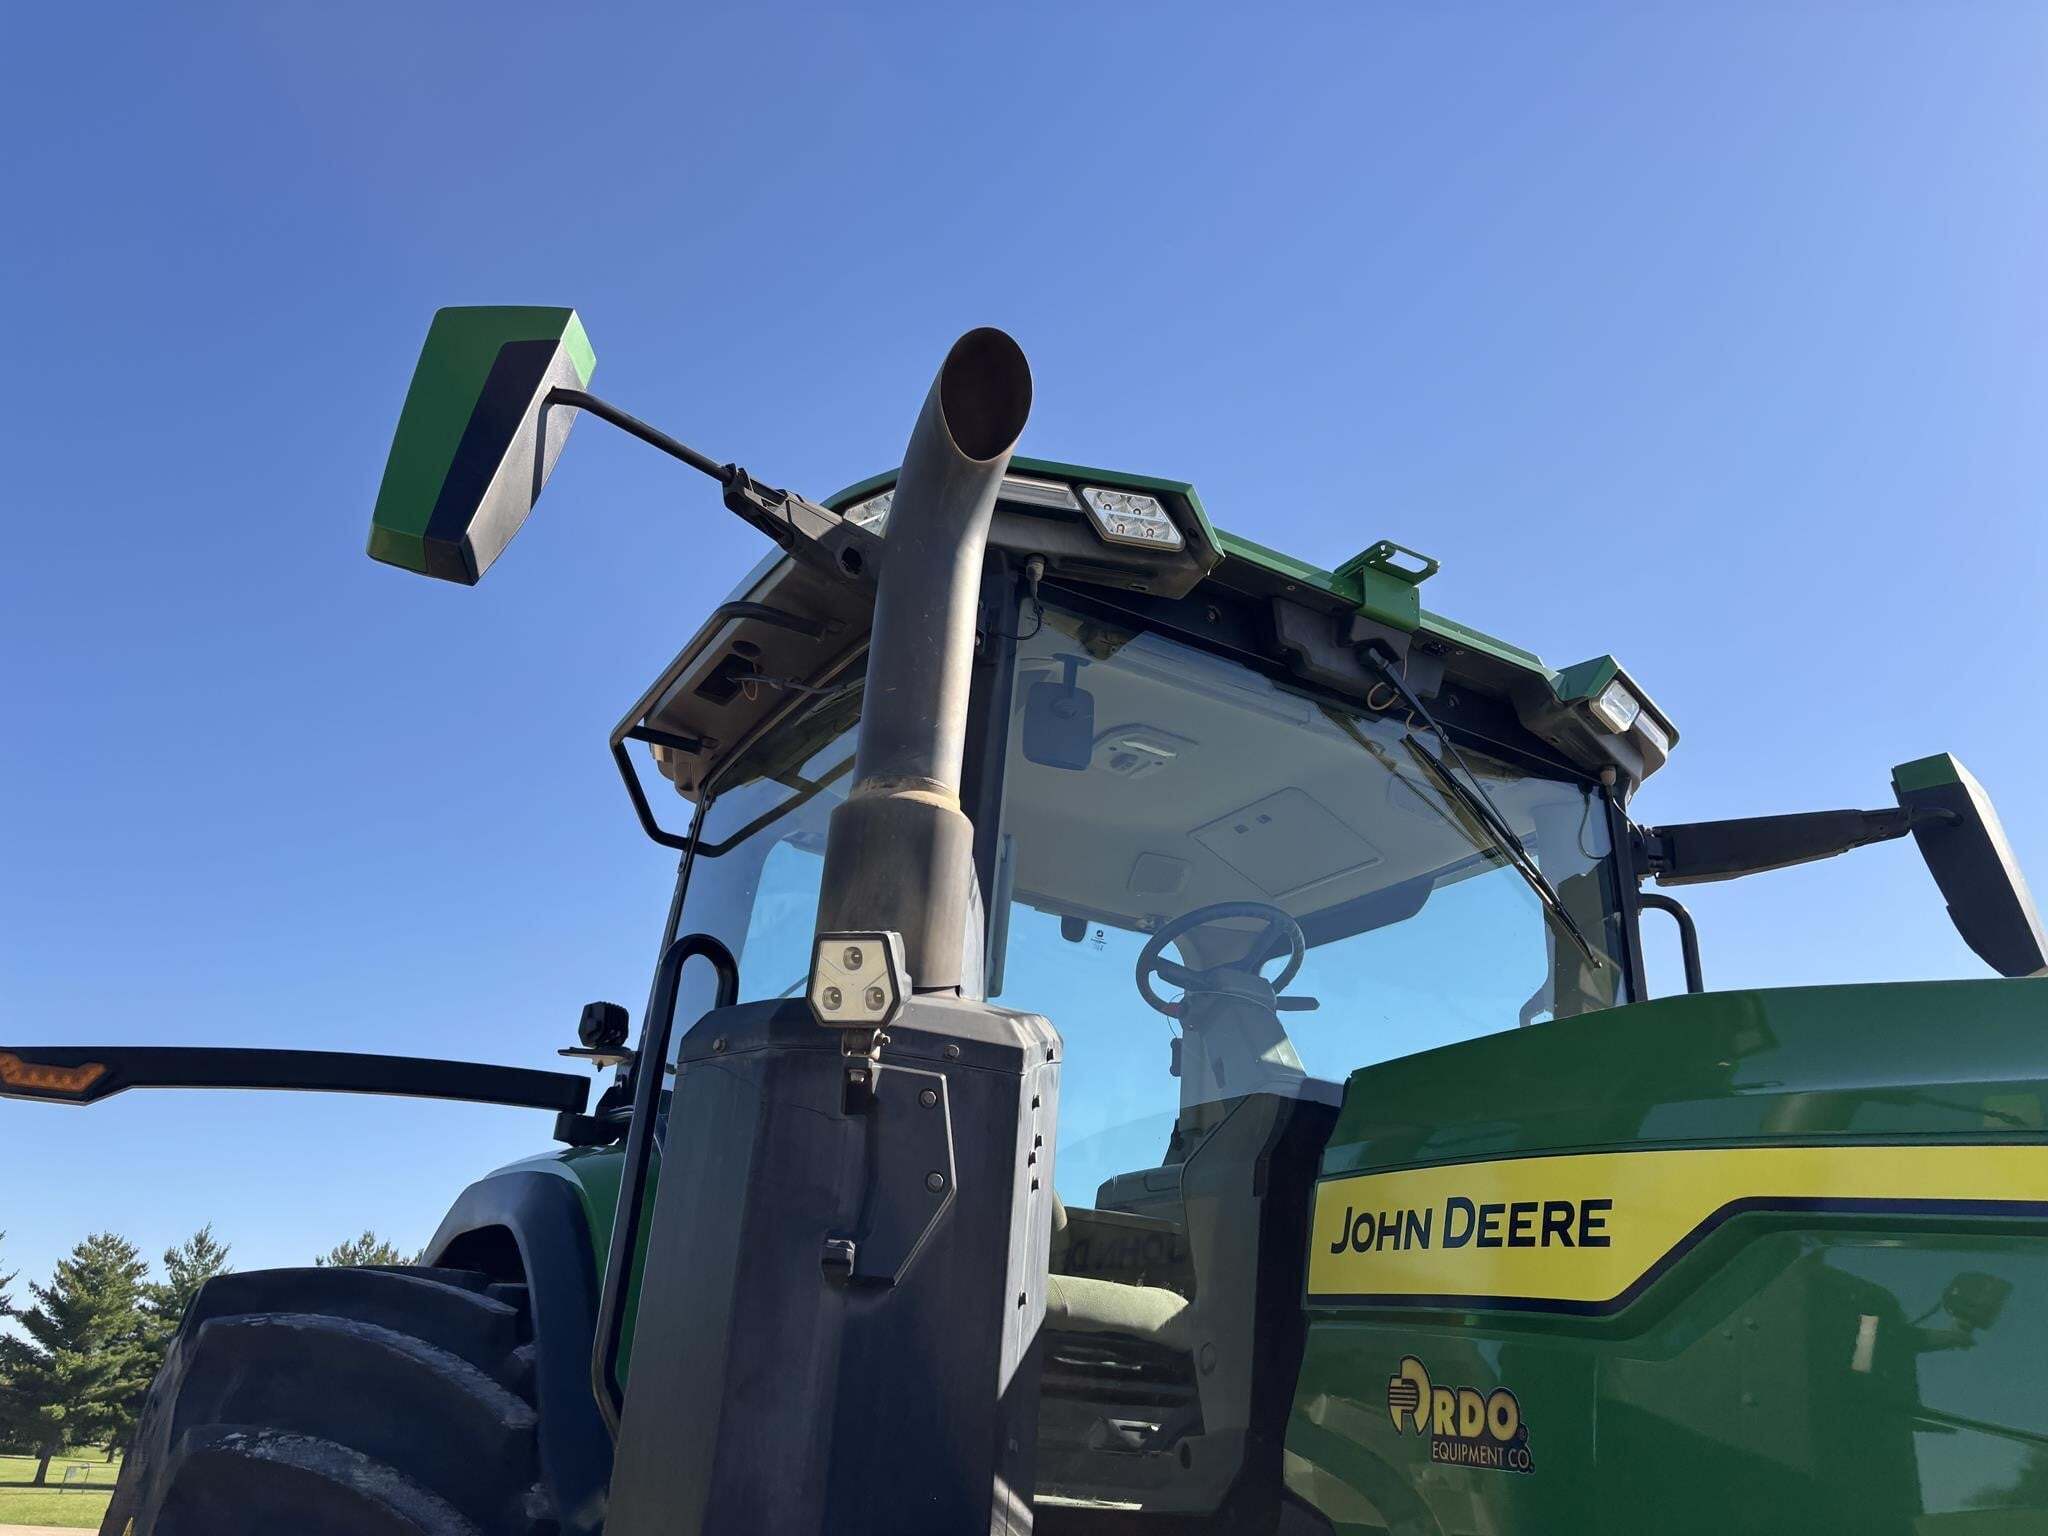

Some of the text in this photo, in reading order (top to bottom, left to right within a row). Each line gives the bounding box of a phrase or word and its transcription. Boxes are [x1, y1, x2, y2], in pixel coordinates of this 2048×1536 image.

[1331, 1196, 1613, 1254] JOHN DEERE
[1432, 1441, 1534, 1471] EQUIPMENT CO.
